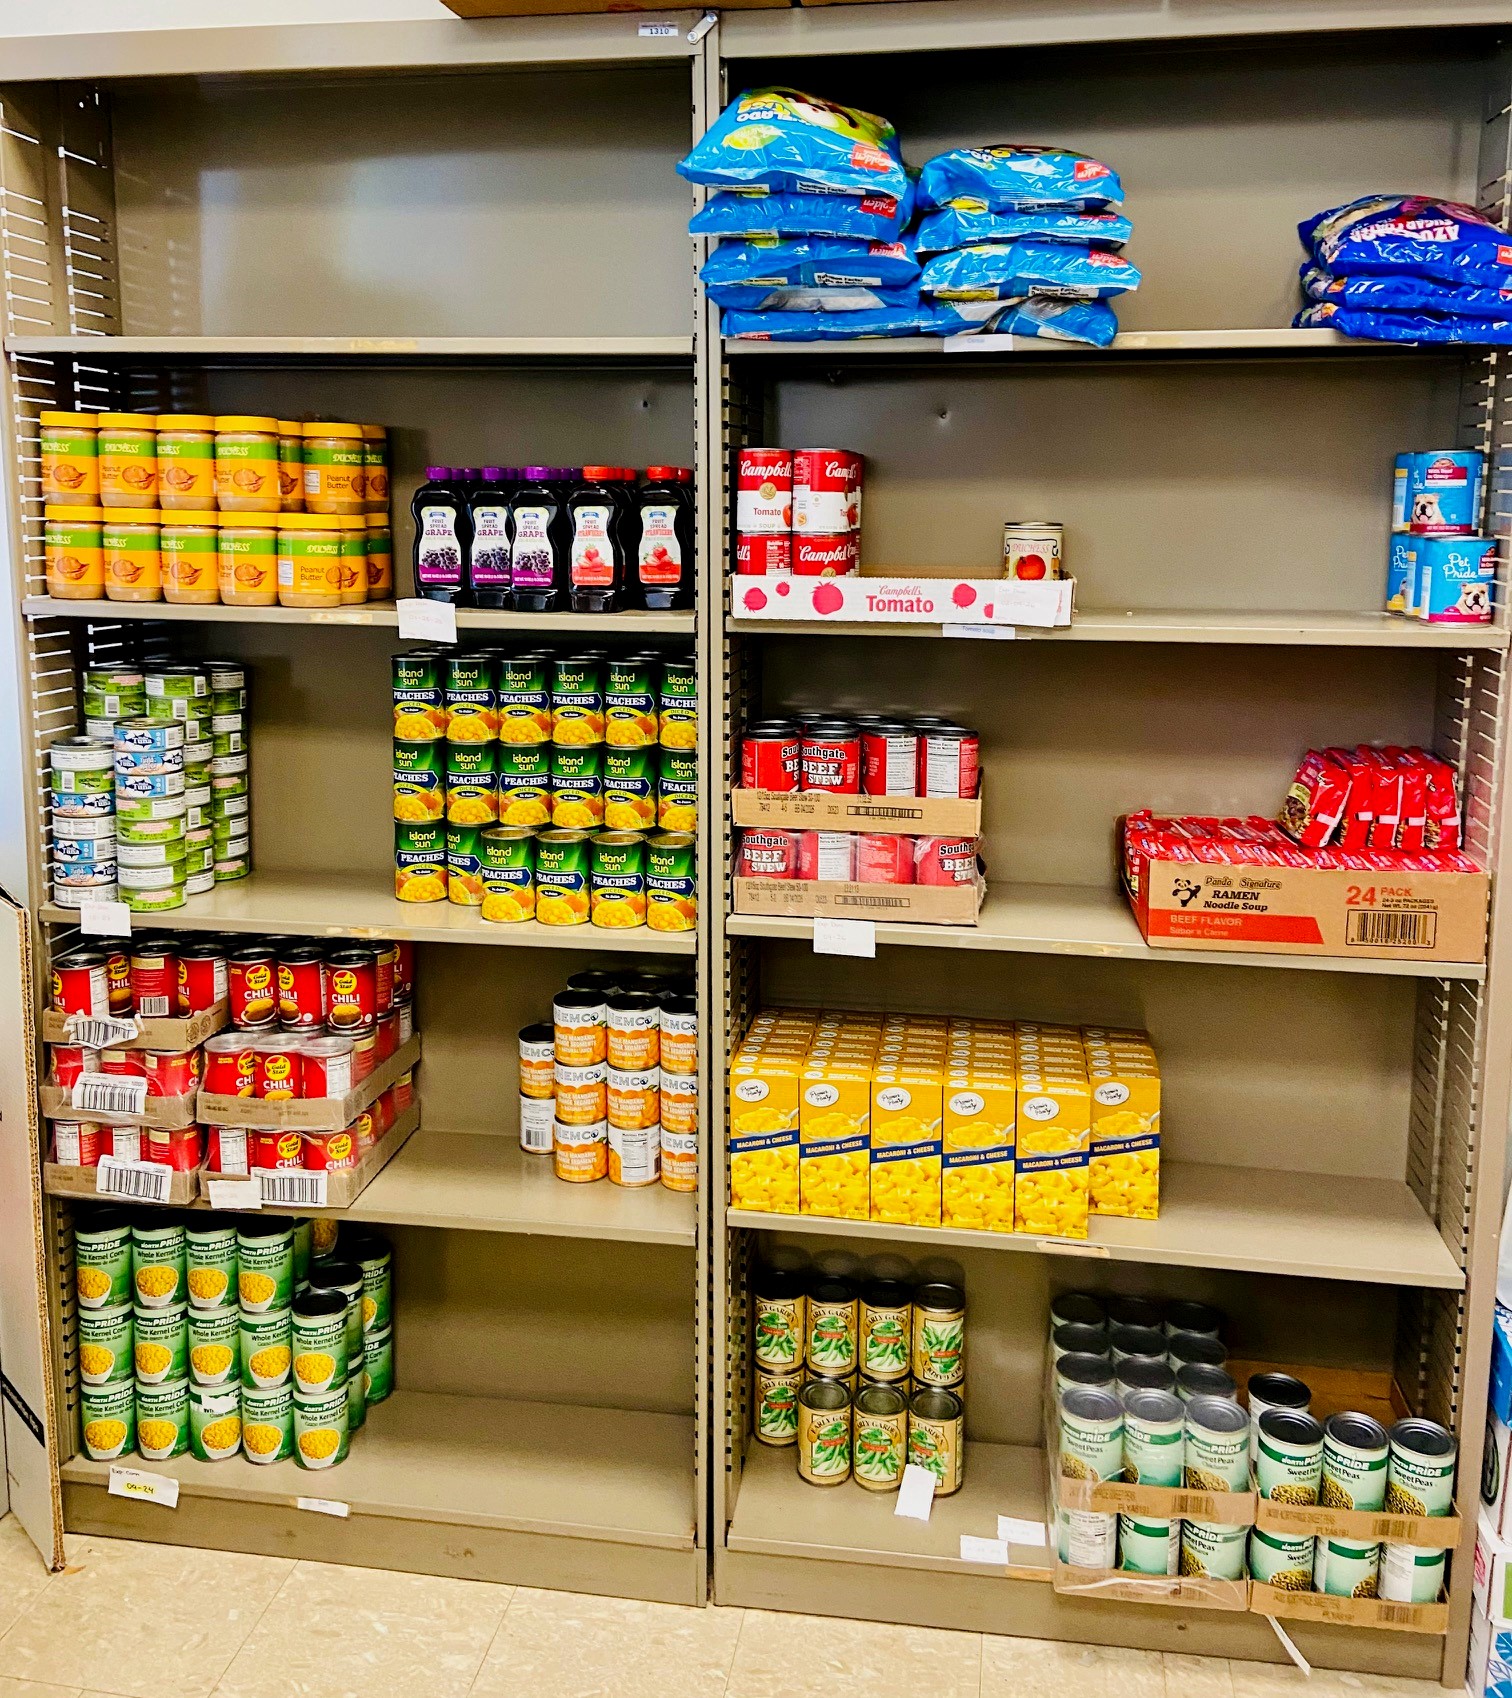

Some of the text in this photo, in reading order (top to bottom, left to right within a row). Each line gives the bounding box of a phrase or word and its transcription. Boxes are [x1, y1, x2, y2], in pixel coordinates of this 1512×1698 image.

[104, 443, 138, 453] DUCHESS
[327, 475, 351, 483] Peanut
[327, 482, 350, 490] Butter
[754, 508, 781, 516] Tomato
[1012, 543, 1051, 554] DUCHESS
[1447, 552, 1471, 567] Pet
[301, 566, 325, 574] Peanut
[1442, 563, 1478, 579] Pride
[301, 573, 323, 581] Butter
[879, 584, 922, 597] Campbell's
[866, 595, 934, 614] Tomato
[447, 692, 489, 702] PEACHES
[500, 694, 542, 703] PEACHES
[553, 695, 595, 705] PEACHES
[606, 697, 646, 706] PEACHES
[662, 697, 696, 708] PEACHE
[558, 755, 584, 766] island
[607, 756, 631, 767] island
[611, 767, 626, 775] sun
[677, 770, 693, 778] sun
[802, 761, 839, 776] BEEF
[449, 775, 491, 785] PEACHES
[505, 776, 548, 786] PEACHES
[553, 779, 594, 789] PEACHES
[809, 775, 843, 786] STEW
[134, 783, 153, 791] Tuna
[409, 831, 436, 841] island
[415, 840, 431, 848] sun
[486, 846, 512, 857] island
[539, 849, 564, 861] island
[744, 848, 783, 862] BEEF
[401, 852, 445, 863] PEACHES
[491, 857, 507, 865] sun
[599, 852, 627, 864] island
[650, 854, 675, 866] island
[544, 861, 559, 869] sun
[605, 863, 621, 871] sun
[654, 865, 670, 874] sun
[752, 862, 787, 872] STEW
[593, 876, 637, 887] PEACHES
[1205, 876, 1282, 890] Panda Signature
[1212, 890, 1260, 901] RAMEN
[1346, 886, 1376, 906] 24
[1381, 887, 1412, 897] PACK
[1203, 901, 1268, 912] Noodle Soup
[1170, 914, 1243, 926] BEEF FLAVOR
[244, 987, 273, 1000] CHILI
[332, 994, 360, 1003] CHILI
[263, 1078, 294, 1090] CHILI
[1094, 1143, 1124, 1152] MACARONI
[1131, 1138, 1153, 1147] CHEESE
[876, 1149, 906, 1159] MACARONI
[912, 1146, 935, 1154] CHEESE
[949, 1153, 980, 1163] MACARONI
[985, 1150, 1008, 1159] CHEESE
[276, 1153, 304, 1169] CHILI
[326, 1155, 355, 1171] CHILI
[1022, 1159, 1053, 1169] MACARONI
[1060, 1155, 1083, 1164] CHEESE
[91, 1238, 121, 1252] PRIDE
[257, 1241, 285, 1256] PRIDE
[95, 1315, 124, 1328] PRIDE
[154, 1312, 181, 1326] PRIDE
[211, 1327, 230, 1338] Kernel
[318, 1320, 344, 1336] PRIDE
[314, 1334, 333, 1345] Kernel
[159, 1388, 185, 1402] PRIDE
[105, 1402, 124, 1413] Kernel
[155, 1402, 175, 1412] Kernel
[261, 1405, 280, 1417] Kernel
[320, 1408, 339, 1421] Kernel
[1337, 1451, 1370, 1471] PRIDE
[1288, 1467, 1309, 1477] Sweet
[1343, 1466, 1361, 1480] Peas
[1410, 1460, 1443, 1477] PRIDE
[1394, 1466, 1434, 1488] Sweet Peas
